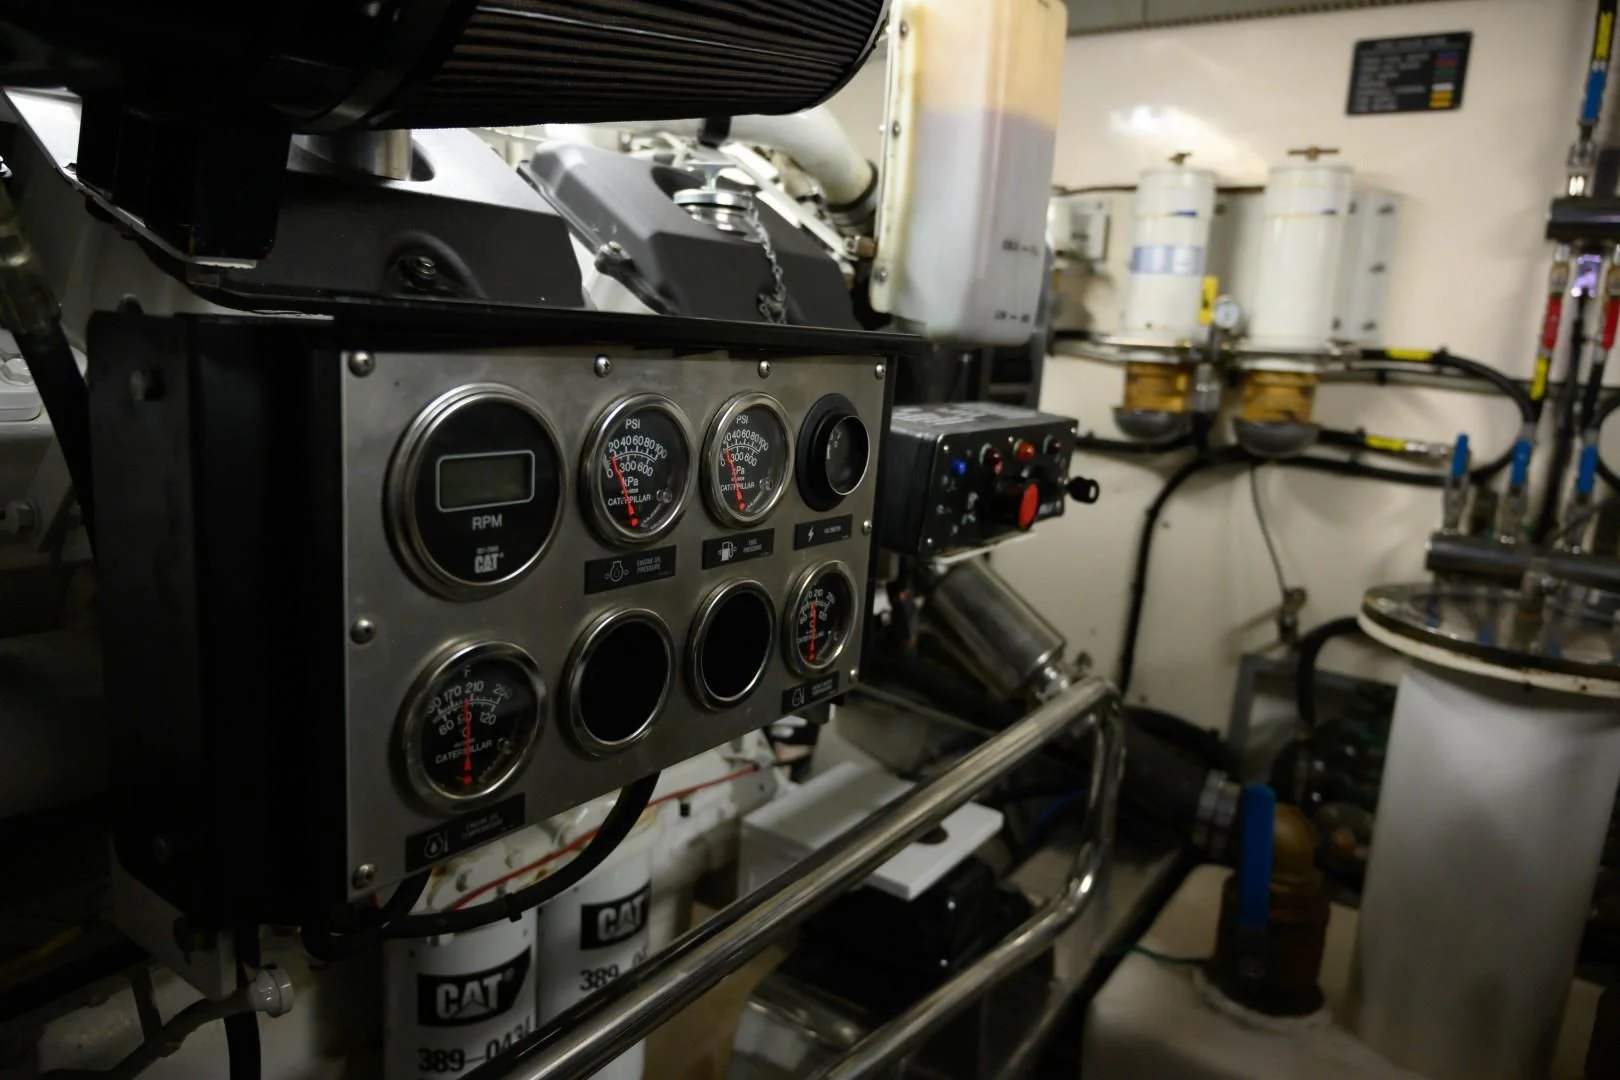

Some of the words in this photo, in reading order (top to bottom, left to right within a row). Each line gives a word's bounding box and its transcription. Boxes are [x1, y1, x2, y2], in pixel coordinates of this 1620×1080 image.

[625, 418, 641, 430] PSI
[736, 415, 749, 424] PSI
[608, 439, 620, 452] 20
[620, 435, 632, 446] 40
[632, 435, 644, 446] 60
[643, 437, 656, 450] 80
[655, 443, 668, 459] 100
[732, 430, 741, 438] 40
[741, 429, 751, 439] 60
[750, 431, 760, 442] 80
[758, 436, 769, 452] 100
[744, 453, 758, 467] 600
[619, 461, 637, 473] 300
[637, 462, 654, 477] 600
[720, 481, 755, 493] CATEILLAR
[471, 513, 503, 531] RPM
[474, 553, 499, 574] CAT
[463, 665, 472, 678] F
[465, 680, 485, 694] 210
[438, 719, 455, 736] 60
[435, 739, 493, 764] CATERILLAR
[597, 893, 645, 942] CAT
[435, 972, 504, 1021] CAT
